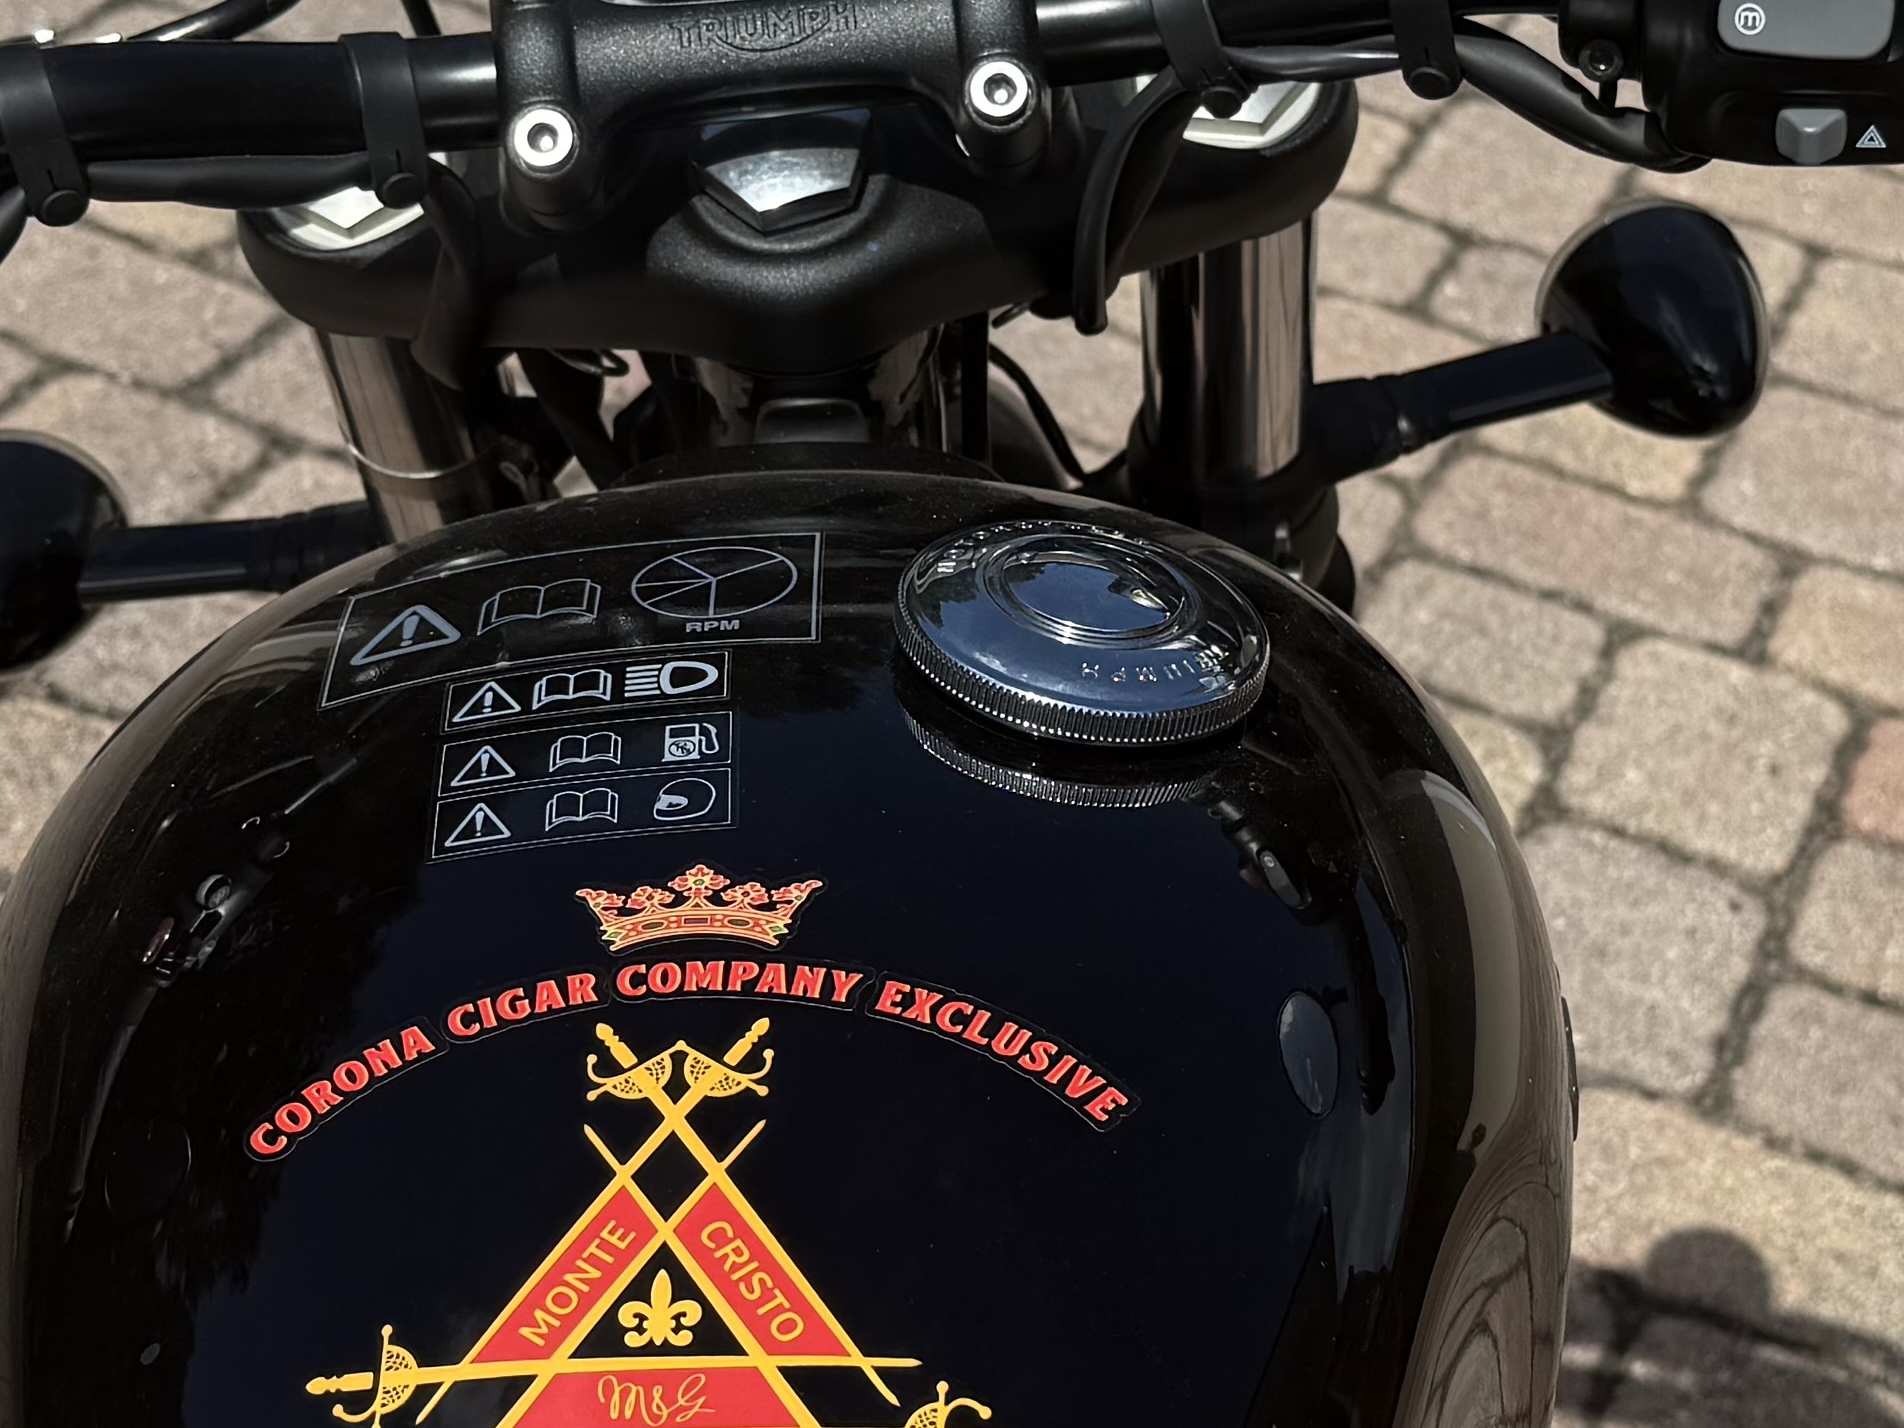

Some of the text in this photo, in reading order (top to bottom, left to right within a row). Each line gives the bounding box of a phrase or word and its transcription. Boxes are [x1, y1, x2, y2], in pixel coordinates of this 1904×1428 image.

[669, 2, 858, 52] TRIUMPH
[685, 619, 740, 633] RPM
[250, 960, 1129, 1155] CORONA CIGAR COMPANY EXCLUSIVE
[518, 1219, 637, 1347] MONTE
[700, 1220, 805, 1342] CRISTO
